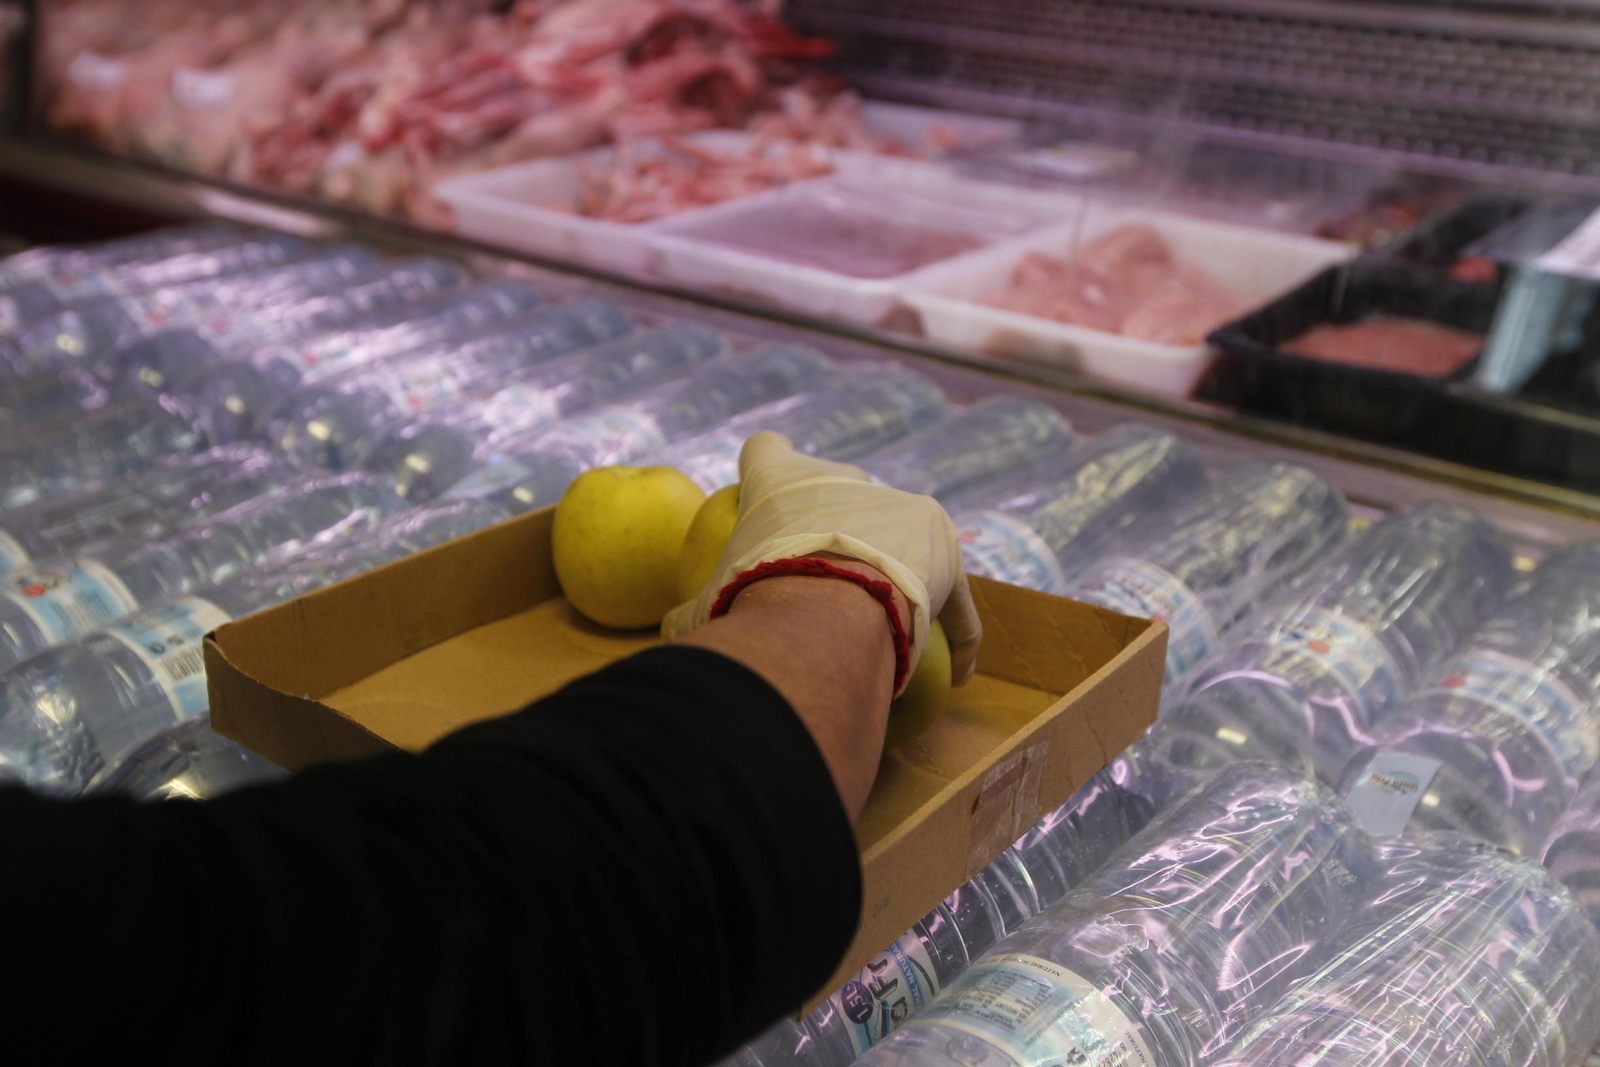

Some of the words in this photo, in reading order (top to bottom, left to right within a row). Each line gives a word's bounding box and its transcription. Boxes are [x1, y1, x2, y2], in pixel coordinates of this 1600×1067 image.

[867, 958, 899, 1002] Fr
[890, 943, 916, 985] NATURAL
[1125, 1031, 1147, 1064] NATURAL
